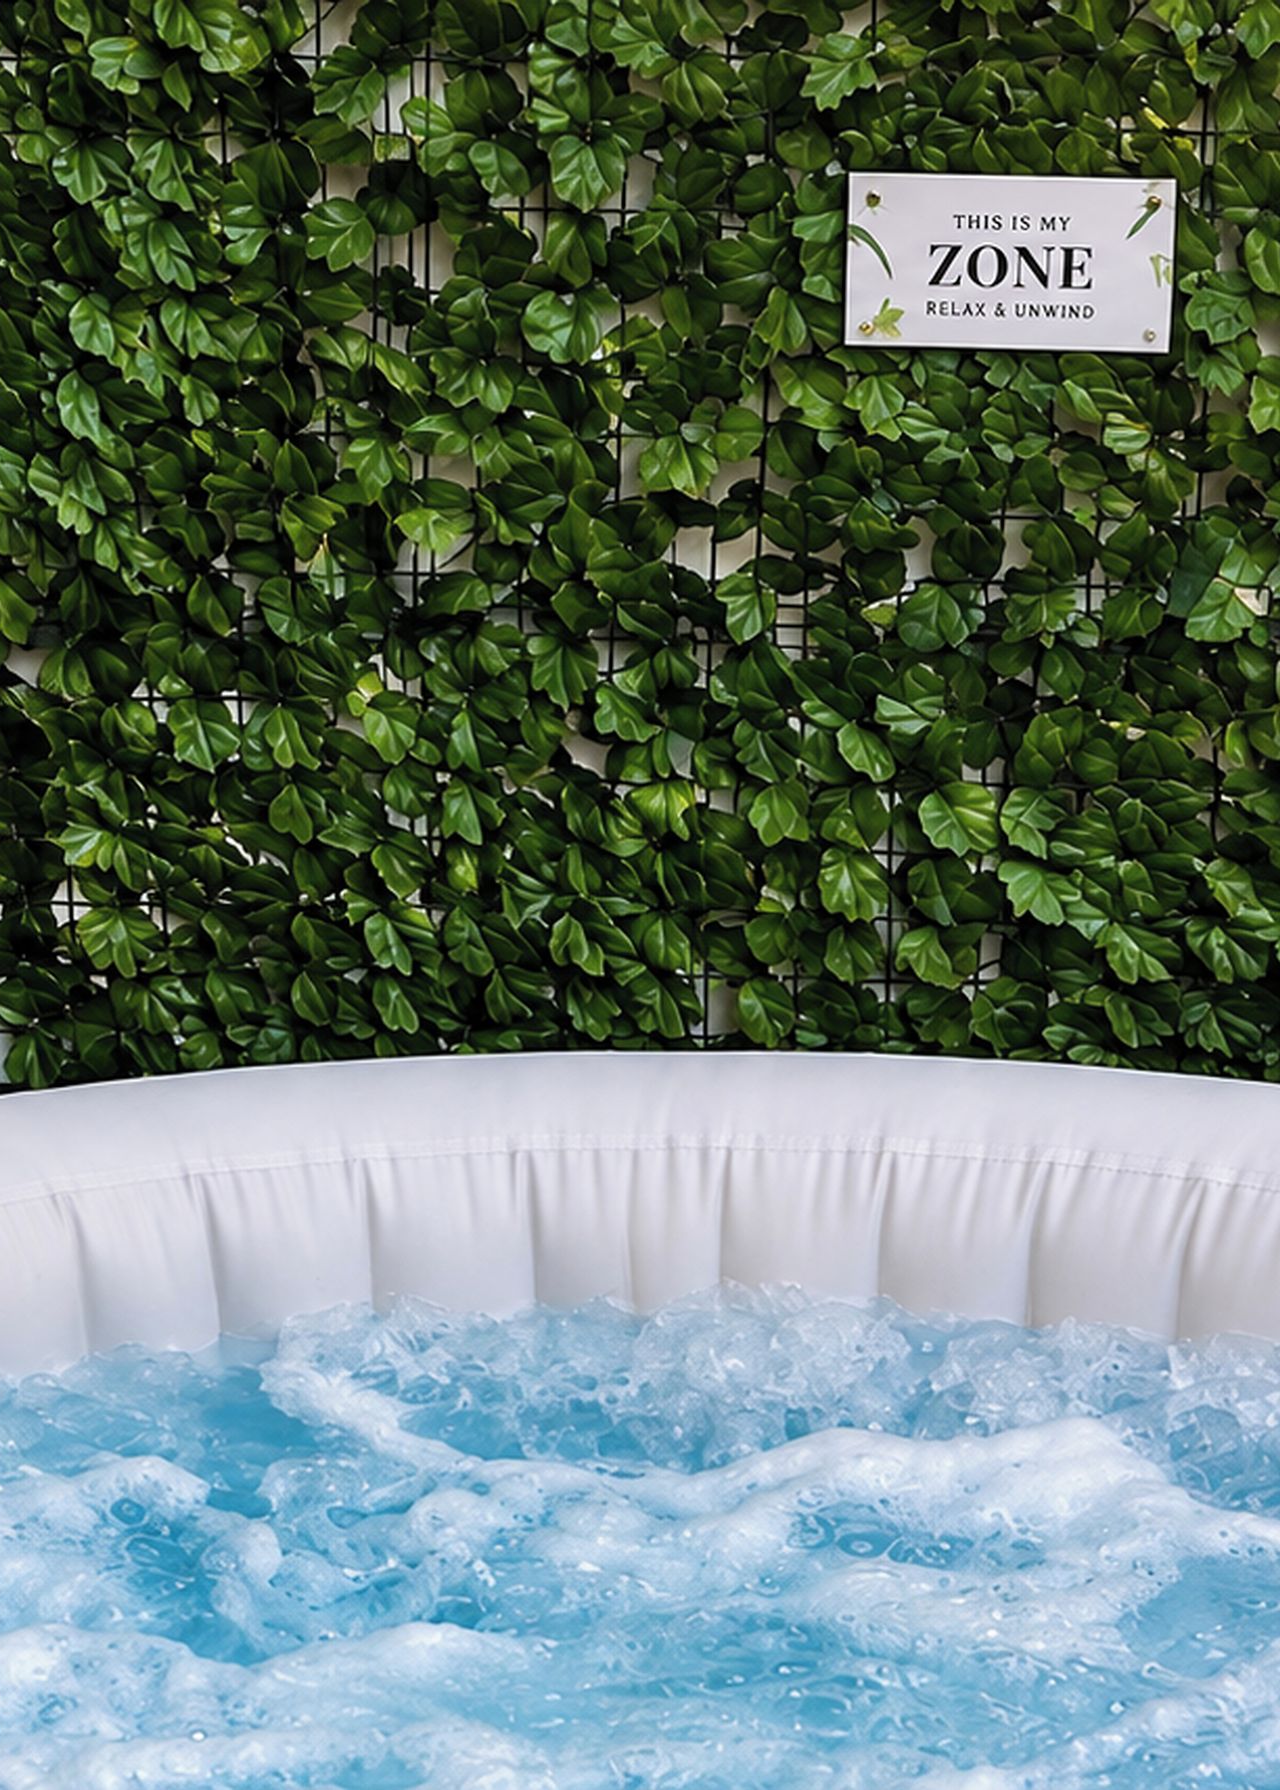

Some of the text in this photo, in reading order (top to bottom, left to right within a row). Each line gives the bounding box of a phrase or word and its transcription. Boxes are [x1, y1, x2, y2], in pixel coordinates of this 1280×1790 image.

[953, 214, 1072, 232] THIS IS MY
[927, 243, 1094, 290] ZONE
[926, 300, 1095, 320] RELAX & UNWIND
